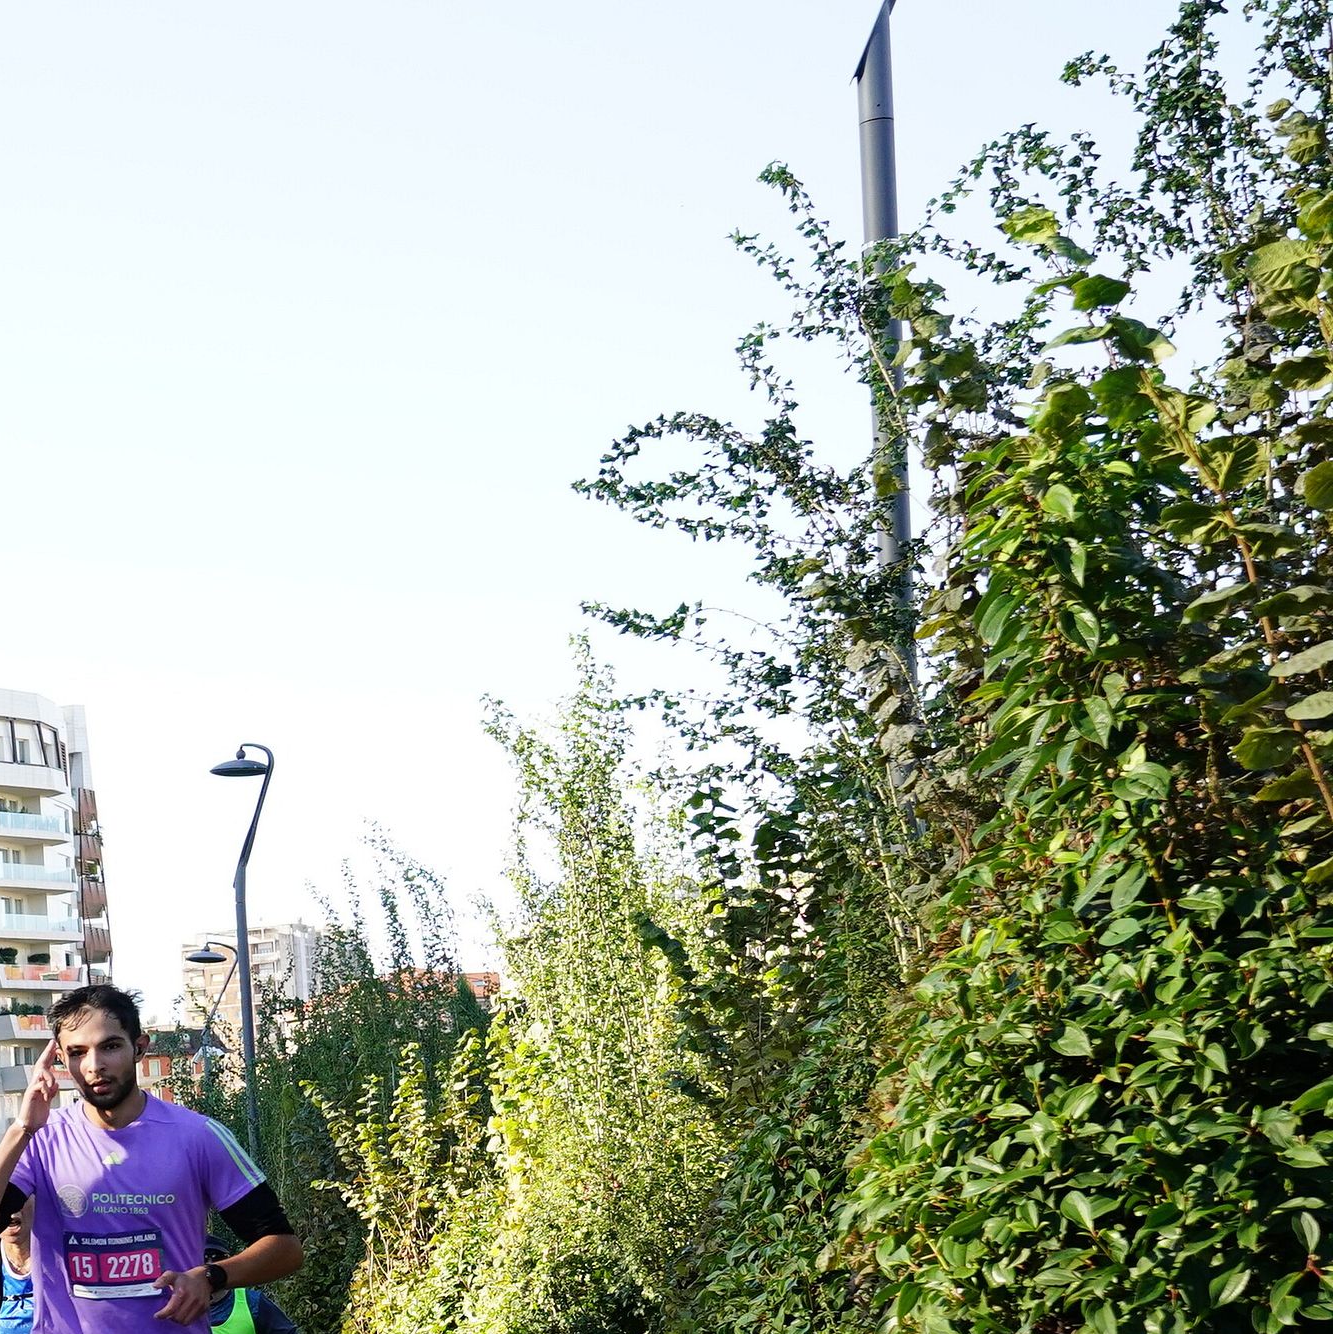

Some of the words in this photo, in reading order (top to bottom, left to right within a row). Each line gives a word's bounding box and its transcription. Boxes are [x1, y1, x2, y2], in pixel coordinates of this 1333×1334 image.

[91, 1192, 175, 1205] POLITECNICO
[93, 1206, 128, 1214] MILANO
[129, 1207, 149, 1215] 1863
[72, 1255, 93, 1279] 15
[107, 1252, 153, 1279] 2278
